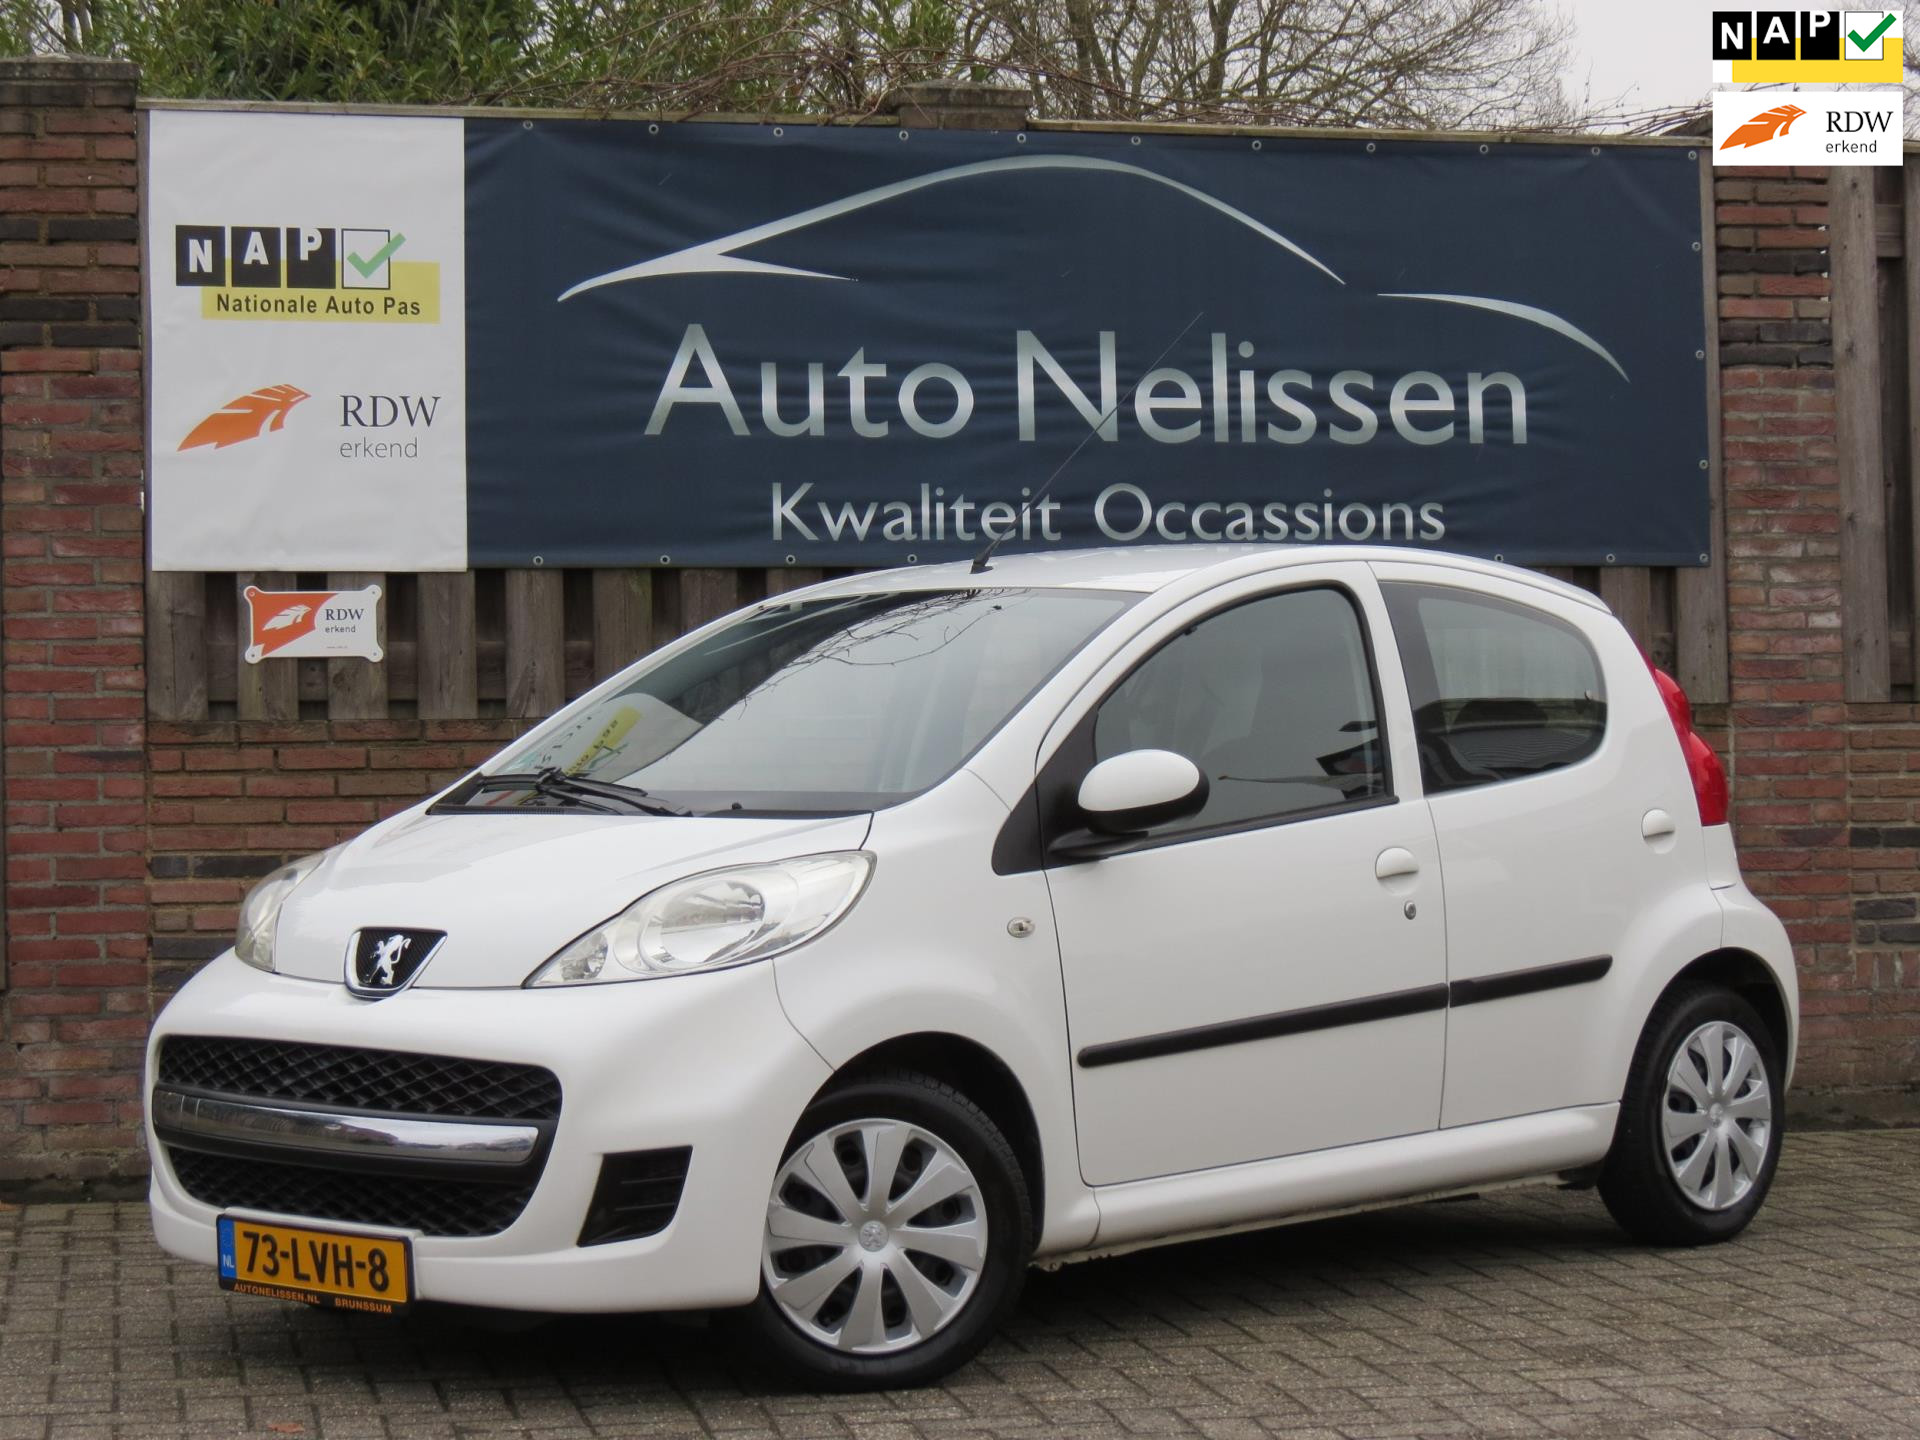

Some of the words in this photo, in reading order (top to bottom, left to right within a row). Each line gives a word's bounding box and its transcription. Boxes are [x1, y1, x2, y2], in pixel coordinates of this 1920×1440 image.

[188, 228, 322, 273] NAP
[217, 294, 317, 313] Nationale
[325, 296, 374, 315] Auto
[383, 297, 421, 315] Pas
[645, 323, 974, 438] Auto
[1017, 330, 1529, 446] Nelissen
[340, 395, 441, 427] RDW
[340, 437, 418, 458] erkend
[771, 482, 1061, 542] Kwaliteit
[1095, 481, 1446, 542] Occassions
[325, 608, 364, 621] RDW
[325, 625, 356, 633] erkend
[222, 1254, 235, 1268] NL
[243, 1231, 389, 1292] 73-LVH-8
[233, 1283, 320, 1304] AUTONELISSEN.NL
[335, 1298, 392, 1313] BRUNSSUM
